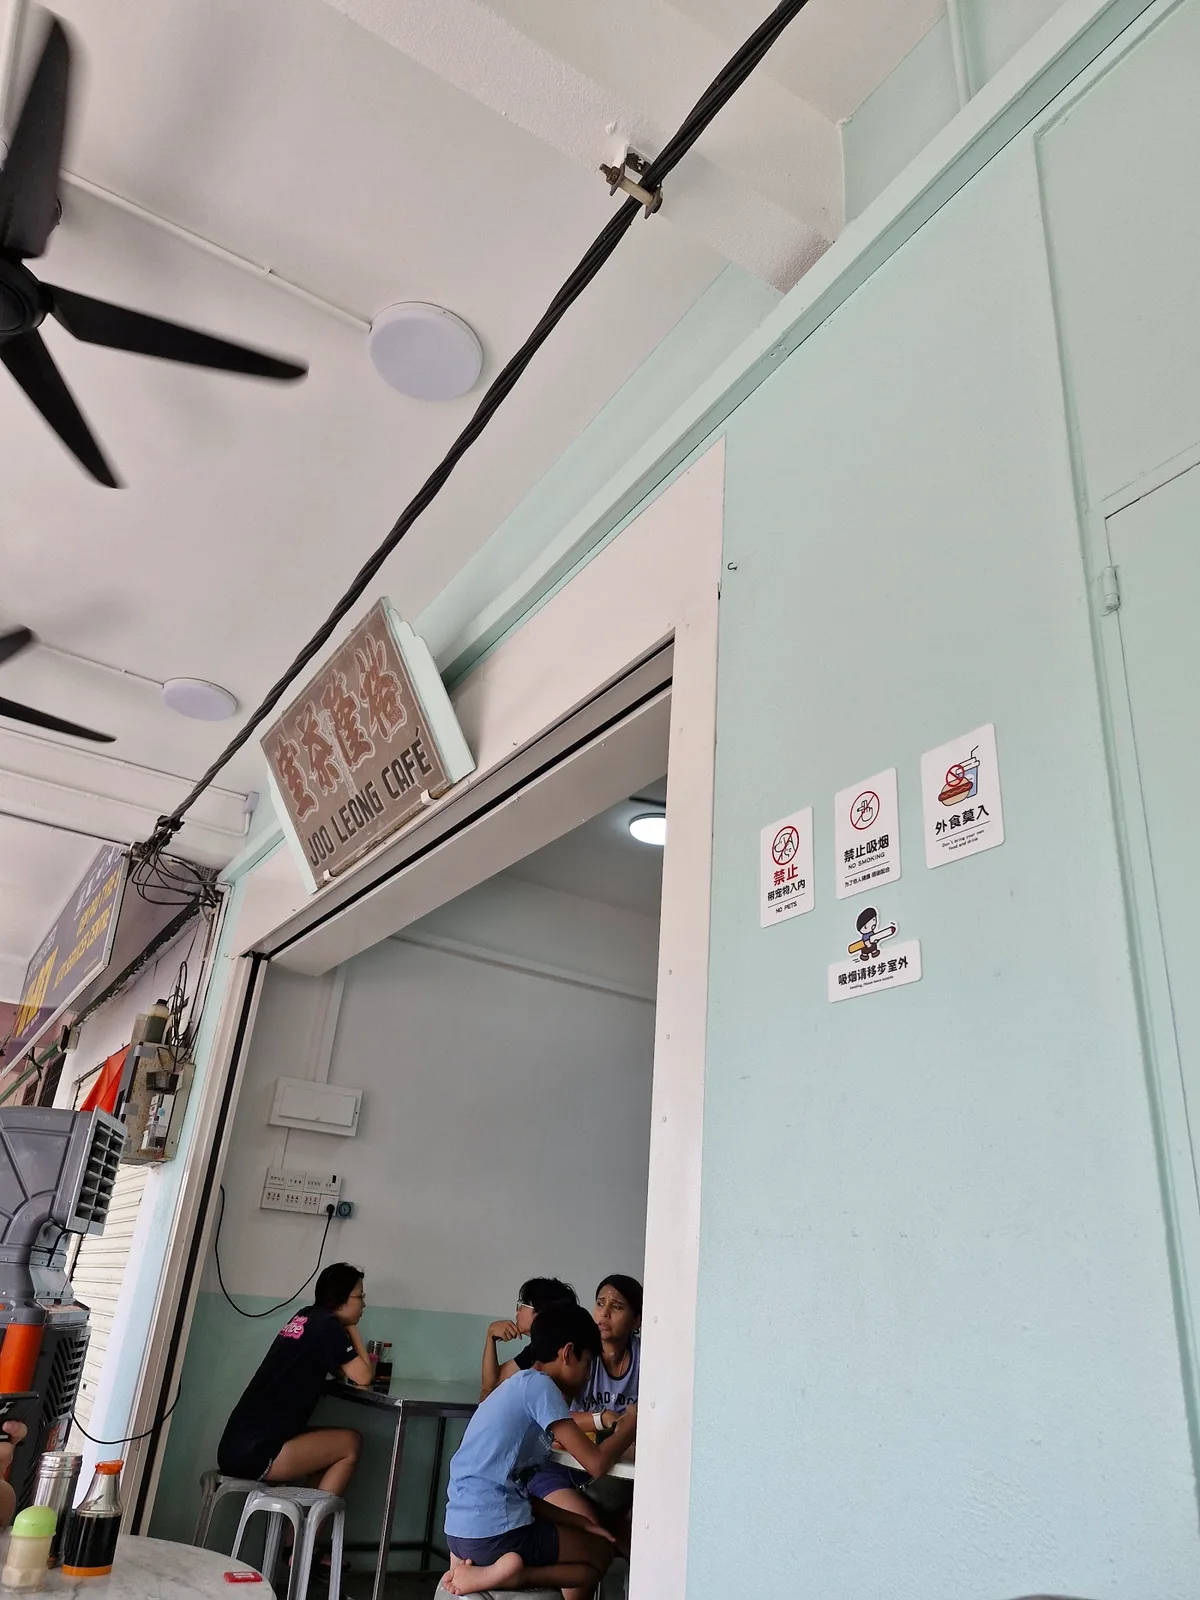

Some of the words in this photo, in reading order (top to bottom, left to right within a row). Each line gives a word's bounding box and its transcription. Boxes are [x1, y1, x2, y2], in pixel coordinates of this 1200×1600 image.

[308, 828, 334, 868] JOO
[333, 781, 385, 845] LEONG
[380, 727, 434, 801] CAFÉ
[935, 804, 990, 836] 外食莫入
[844, 834, 890, 863] 禁止吸烟
[848, 862, 857, 870] NO
[858, 851, 886, 867] SMOKING
[773, 864, 799, 886] 禁止
[767, 879, 806, 902] 带宠物入内
[775, 906, 783, 914] NO
[784, 901, 797, 911] PETS
[837, 955, 909, 986] 吸烟请移步室外
